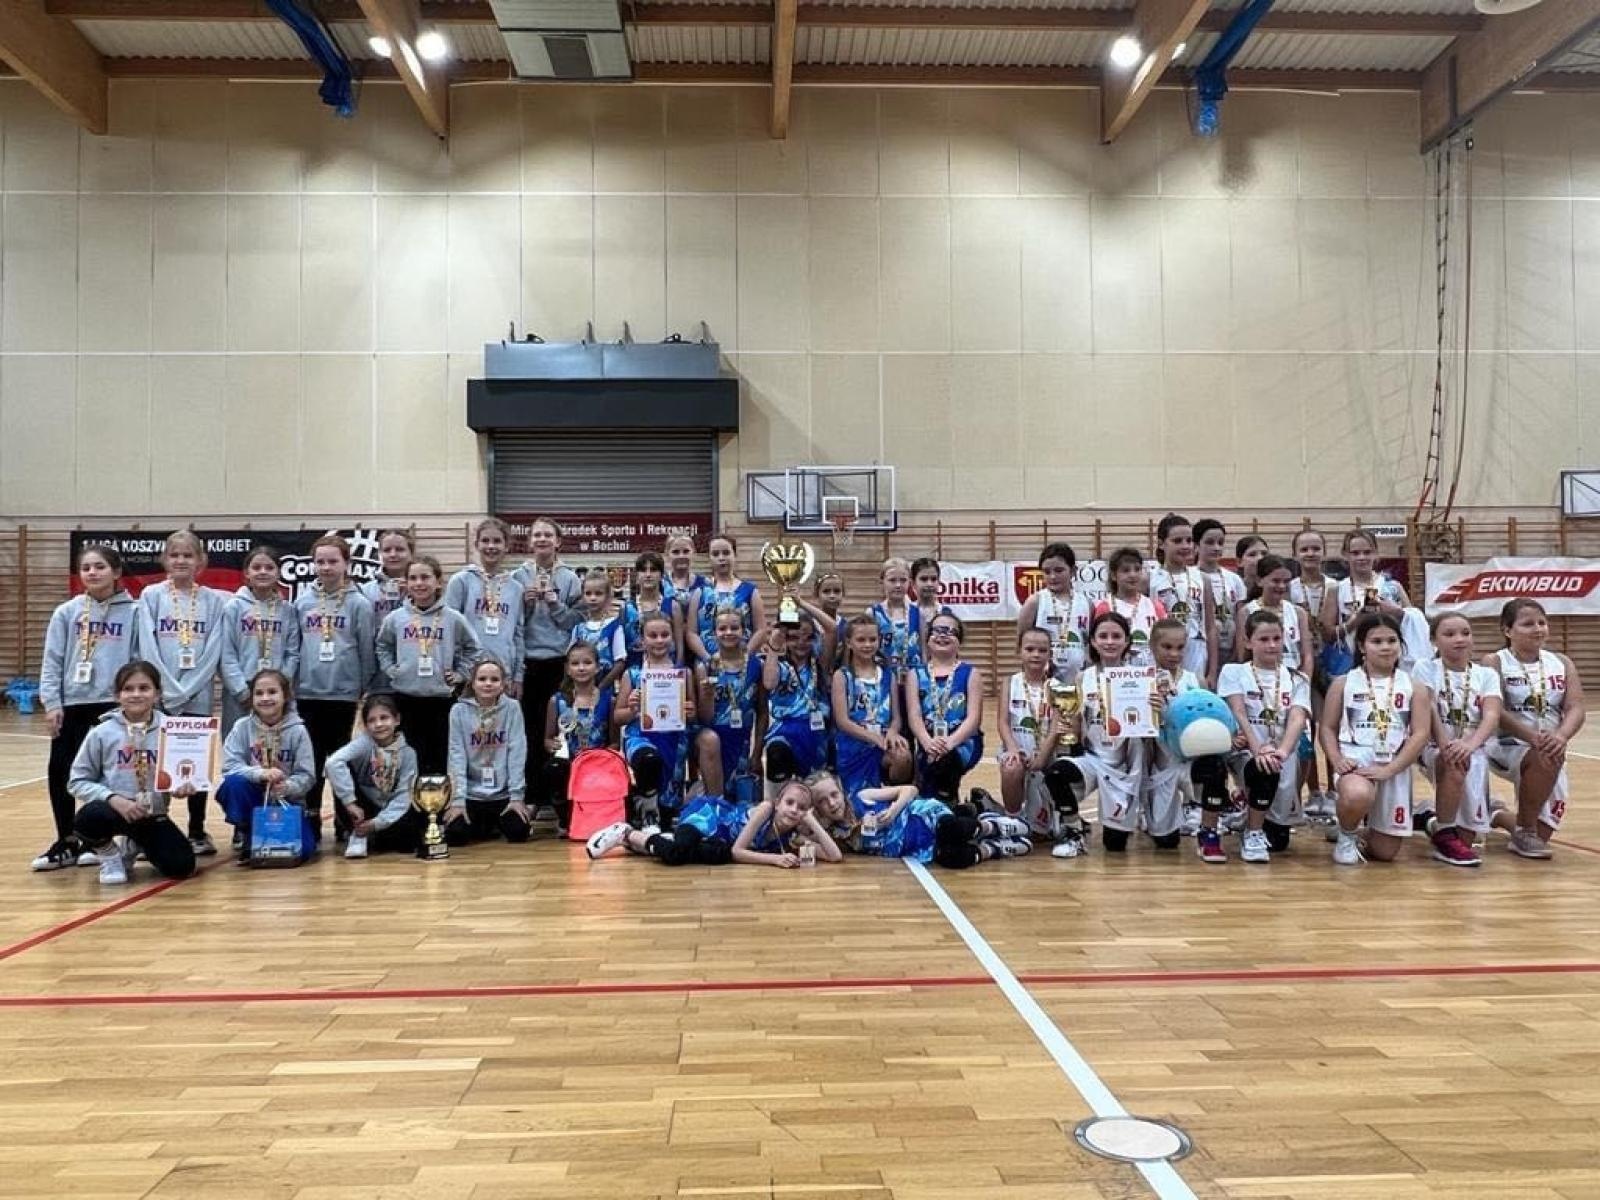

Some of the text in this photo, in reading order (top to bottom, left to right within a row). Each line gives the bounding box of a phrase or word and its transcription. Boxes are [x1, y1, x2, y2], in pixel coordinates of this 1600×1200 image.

[559, 523, 597, 535] środek
[601, 524, 637, 537] Sportu
[640, 524, 644, 535] i
[207, 538, 251, 552] KOBIET
[580, 540, 629, 551] w Bochni
[936, 577, 999, 595] onika
[1477, 576, 1583, 593] EKOMBUD
[1547, 674, 1566, 690] 15
[1281, 692, 1290, 707] 5
[1395, 693, 1404, 709] 8
[1395, 806, 1405, 824] 8
